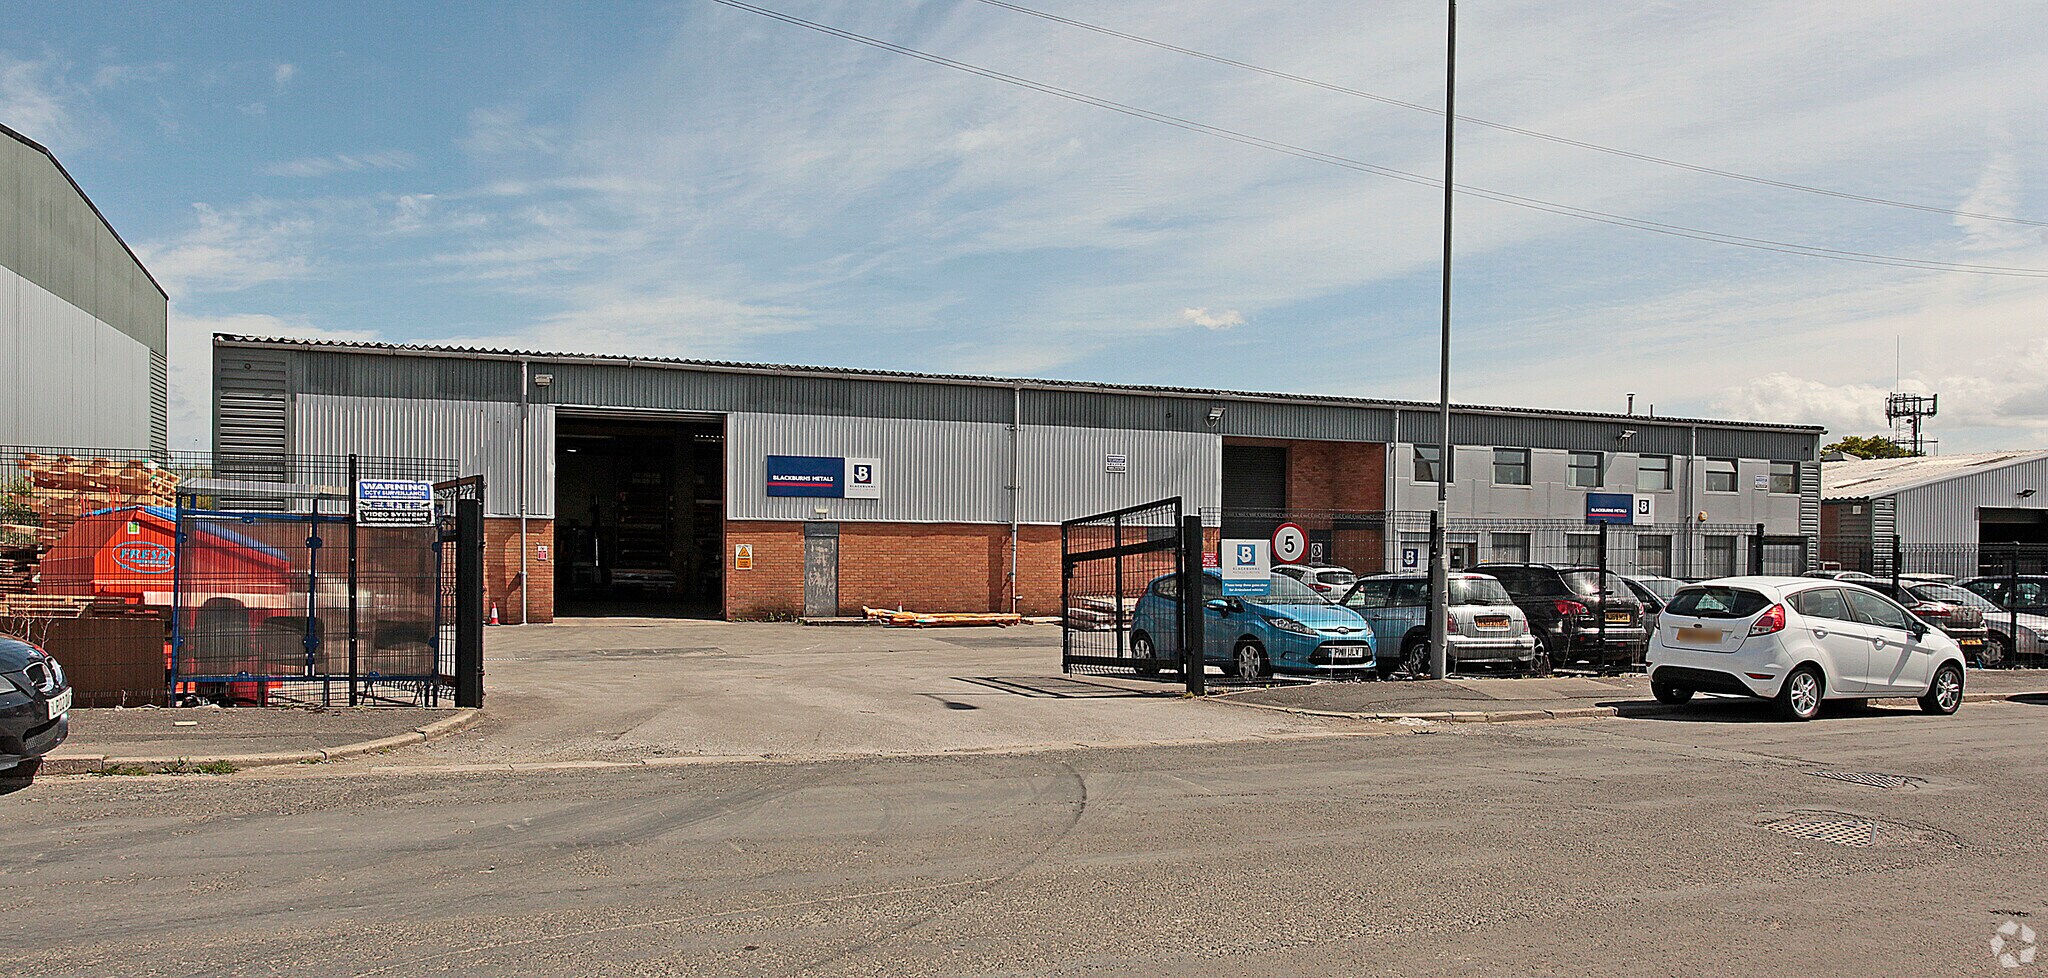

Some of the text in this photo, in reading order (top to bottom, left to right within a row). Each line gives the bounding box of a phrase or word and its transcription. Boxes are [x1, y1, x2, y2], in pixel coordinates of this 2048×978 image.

[855, 466, 869, 481] B
[361, 483, 427, 491] WARNING
[1284, 536, 1295, 553] 5
[120, 548, 171, 560] FRESH
[1237, 546, 1253, 563] B
